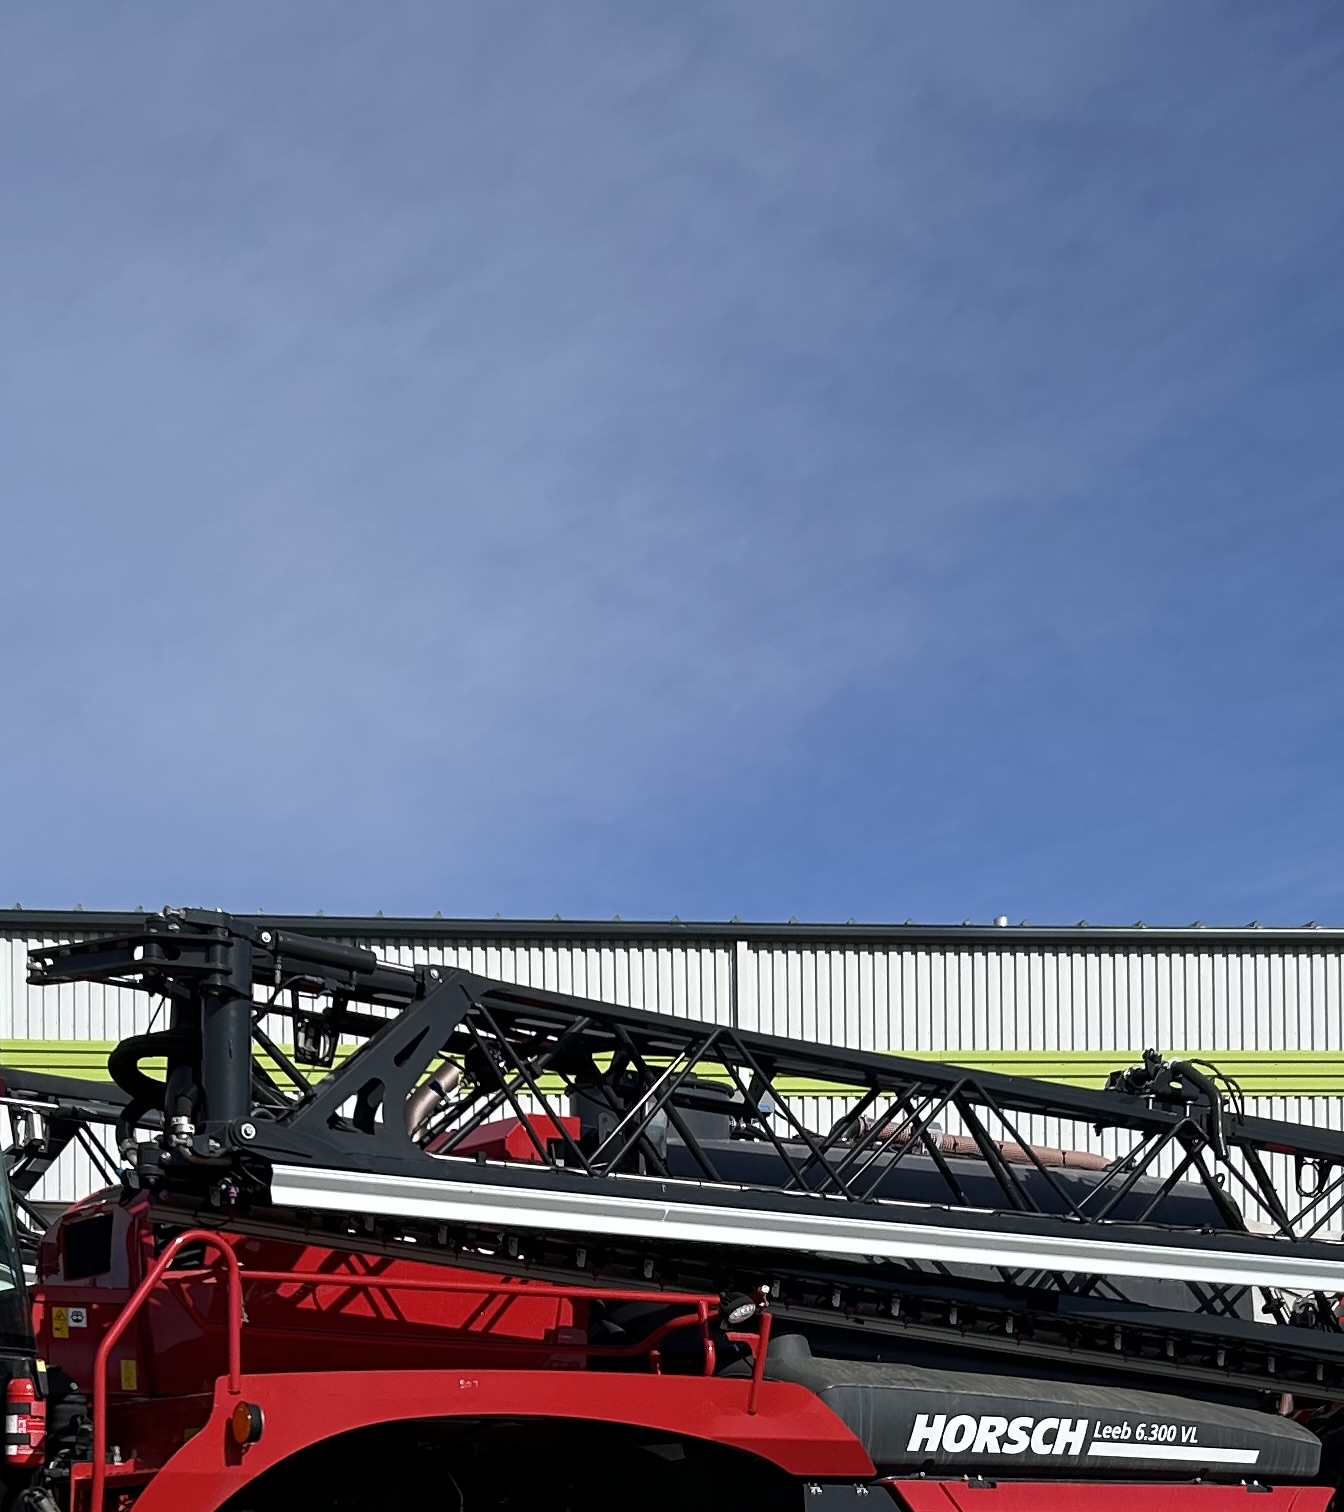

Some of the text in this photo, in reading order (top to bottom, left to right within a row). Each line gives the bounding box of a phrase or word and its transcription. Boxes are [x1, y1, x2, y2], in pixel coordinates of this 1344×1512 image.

[906, 1413, 1199, 1456] HORSCH Leeb 6.300 VL
